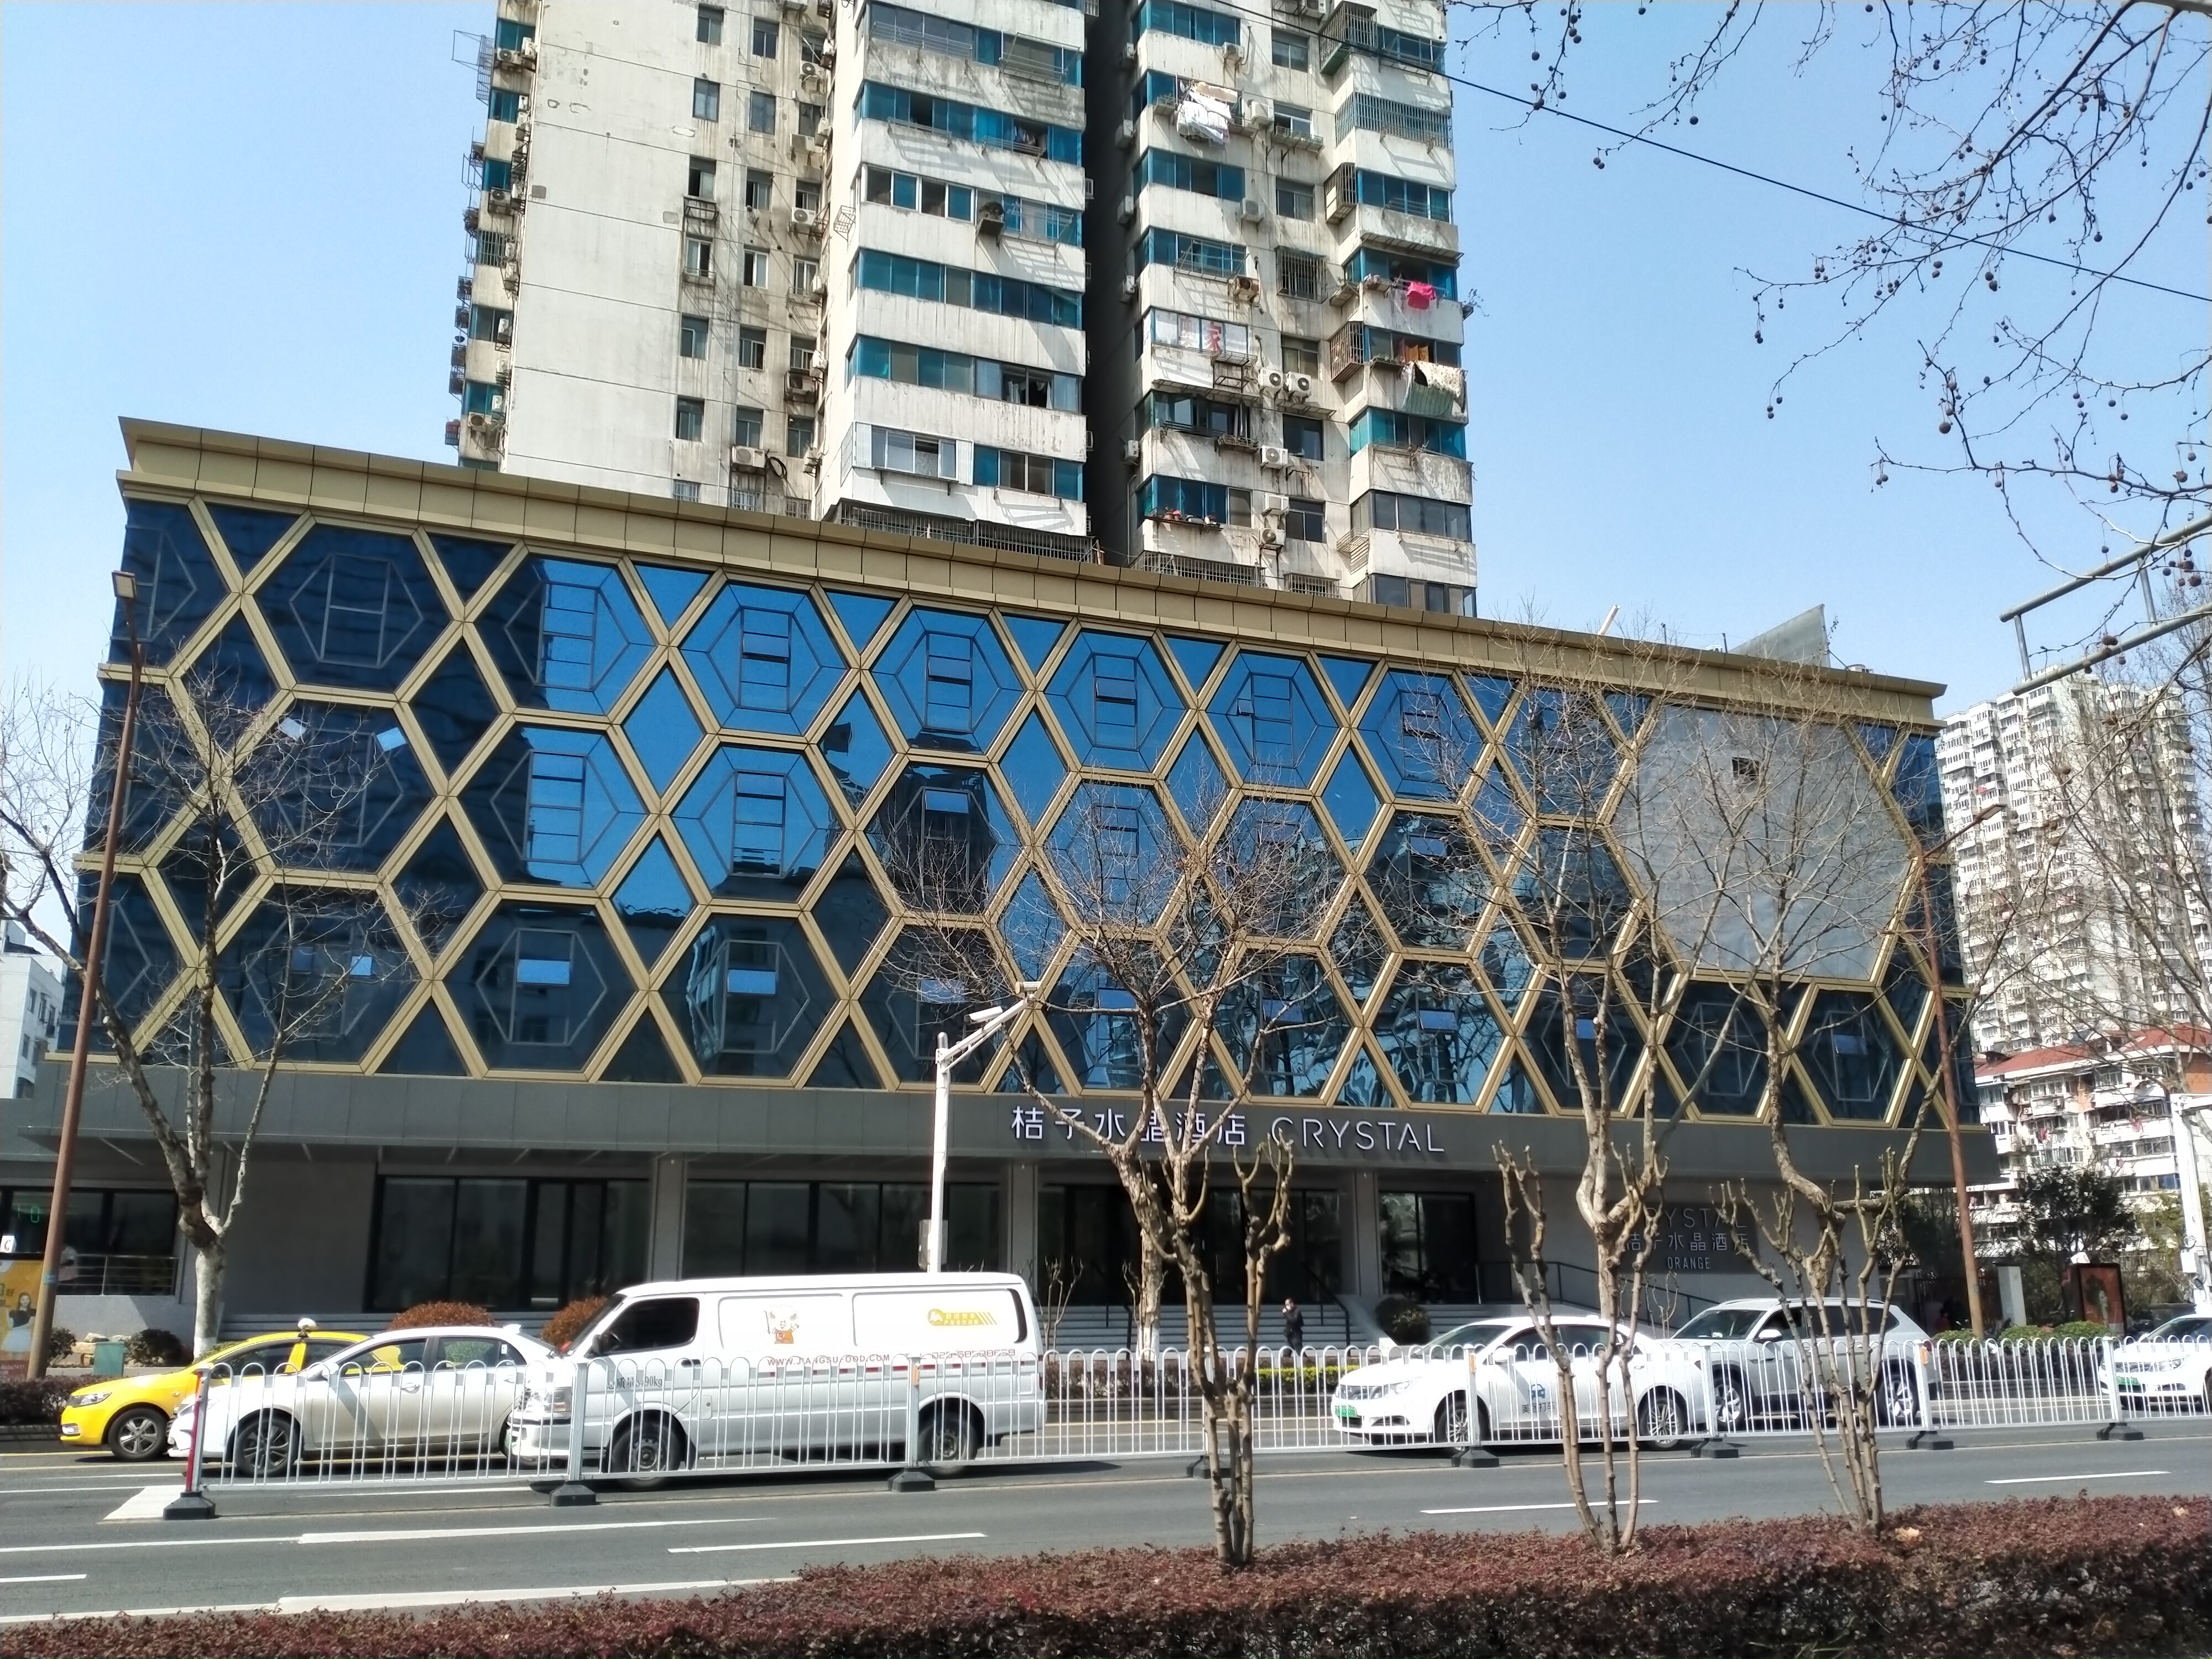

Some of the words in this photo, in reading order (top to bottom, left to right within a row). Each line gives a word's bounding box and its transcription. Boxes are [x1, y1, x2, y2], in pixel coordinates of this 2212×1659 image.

[1011, 1105, 1245, 1145] 桔子水晶酒店
[1271, 1117, 1445, 1152] CRYSTAL
[1645, 1207, 1747, 1228] RYSTL
[1667, 1256, 1711, 1269] ORANGE
[767, 1354, 890, 1366] WWW.JANGSUOOD.COM
[1522, 1401, 1556, 1413] 美团打车
